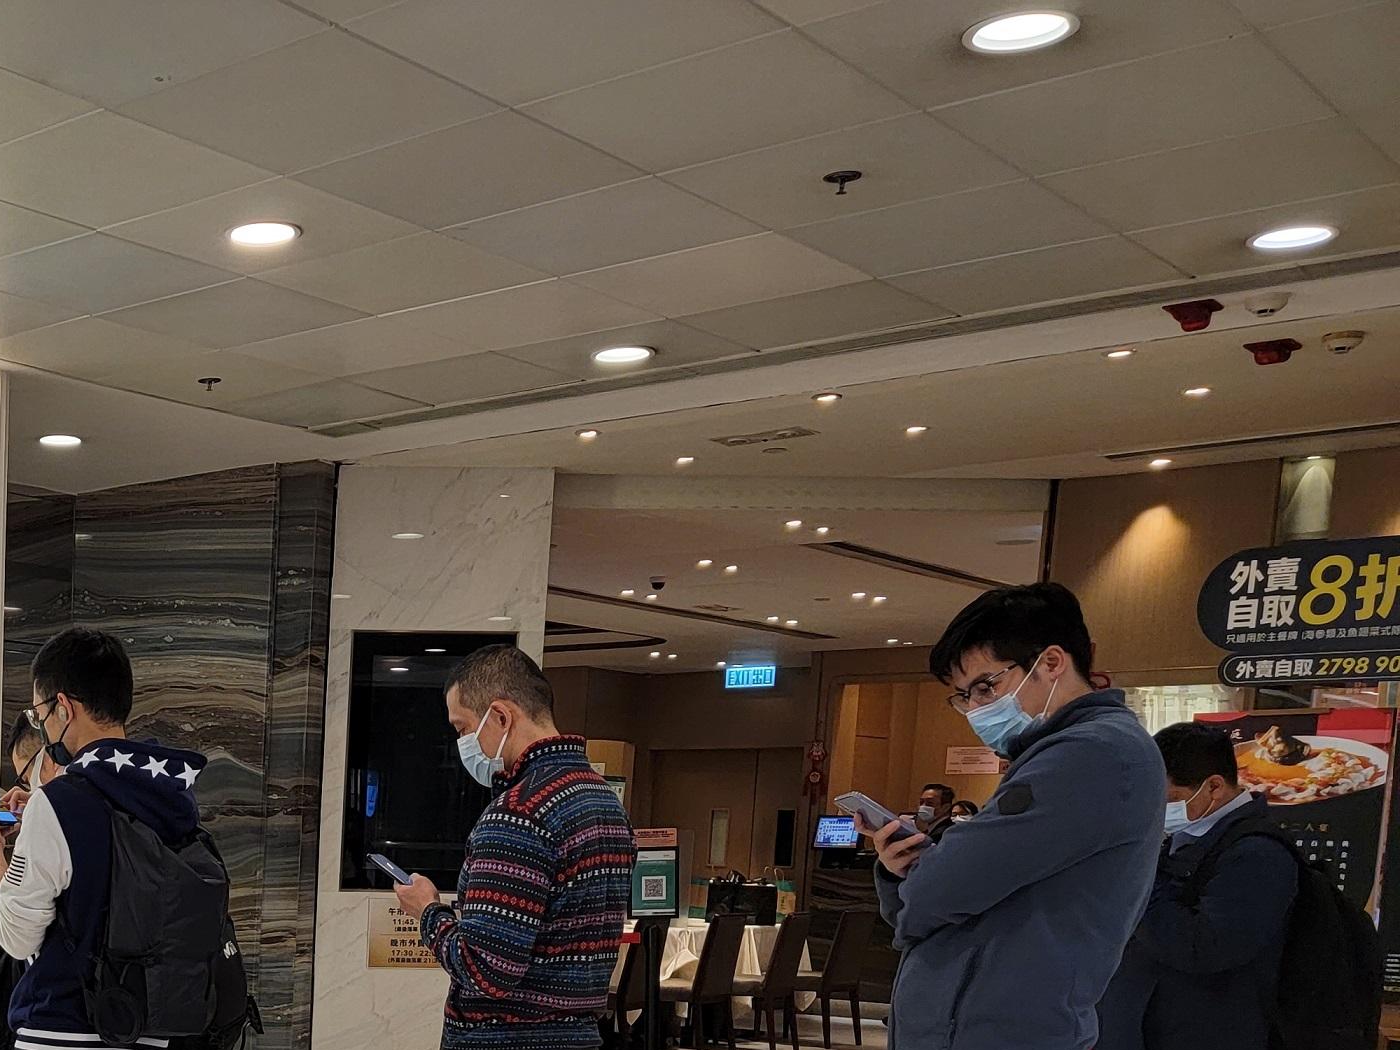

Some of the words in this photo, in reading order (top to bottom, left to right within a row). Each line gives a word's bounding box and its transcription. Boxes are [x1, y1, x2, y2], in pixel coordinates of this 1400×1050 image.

[1229, 557, 1301, 595] 外賣
[1298, 553, 1400, 626] 8折
[1226, 595, 1297, 631] 自取
[752, 669, 773, 685] 出口
[1235, 658, 1314, 679] 外賣自取
[1315, 656, 1370, 676] 2798
[728, 670, 750, 685] EXIT
[392, 918, 415, 926] 11:45
[391, 949, 414, 957] 17:30
